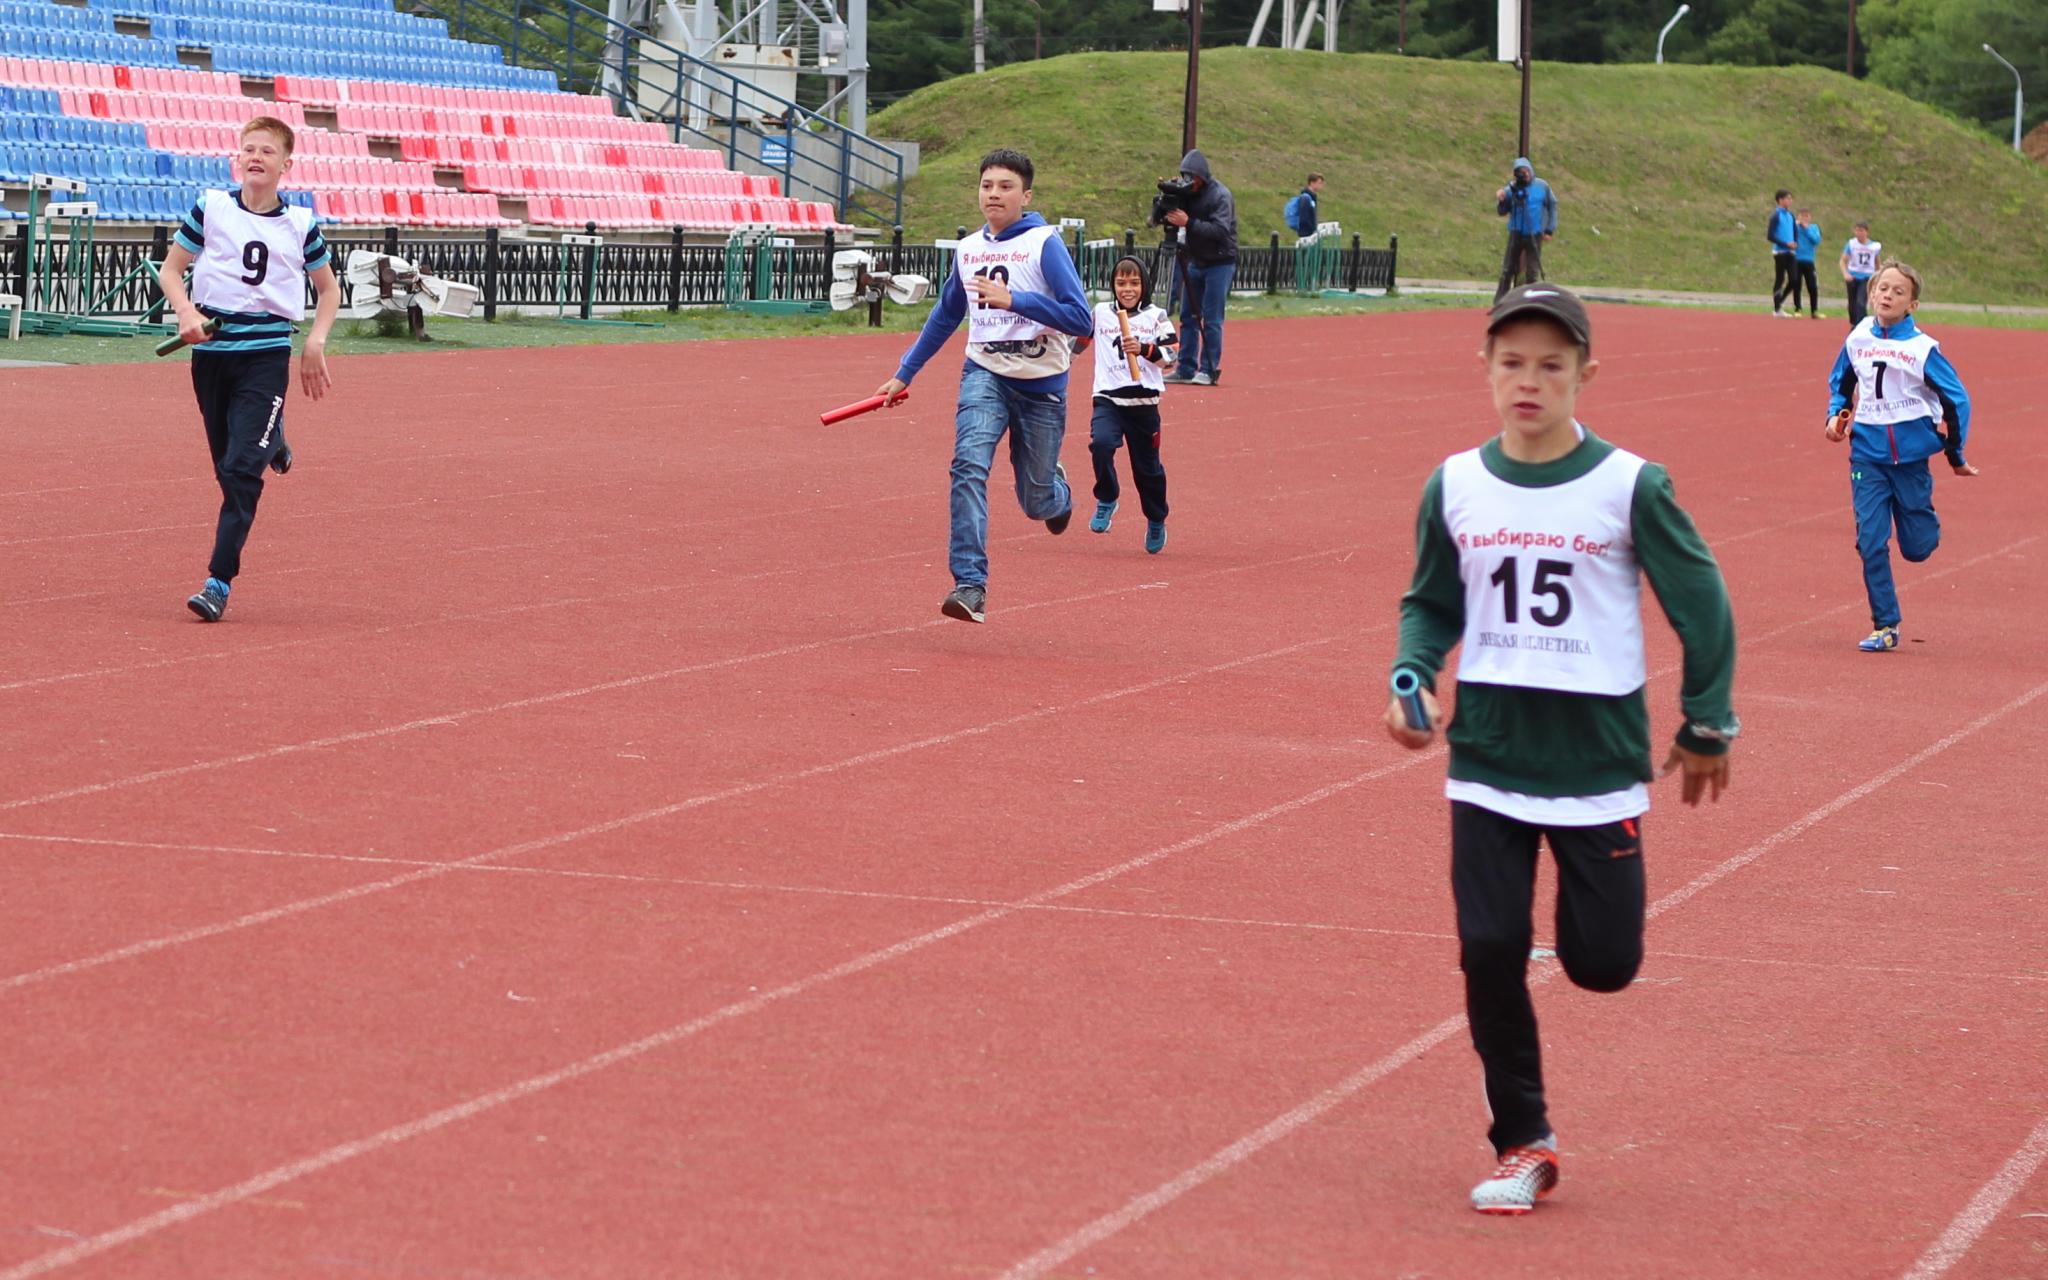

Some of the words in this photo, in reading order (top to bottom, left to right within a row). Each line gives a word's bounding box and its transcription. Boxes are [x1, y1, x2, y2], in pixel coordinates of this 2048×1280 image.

[241, 240, 269, 286] 9
[963, 253, 969, 265] Я
[970, 251, 1009, 265] выбираю
[1011, 250, 1030, 264] бег!
[1858, 252, 1871, 265] 12
[1872, 360, 1887, 399] 7
[259, 395, 283, 449] Reebok
[1457, 533, 1469, 550] Я
[1472, 528, 1566, 550] выбираю
[1490, 556, 1575, 628] 15
